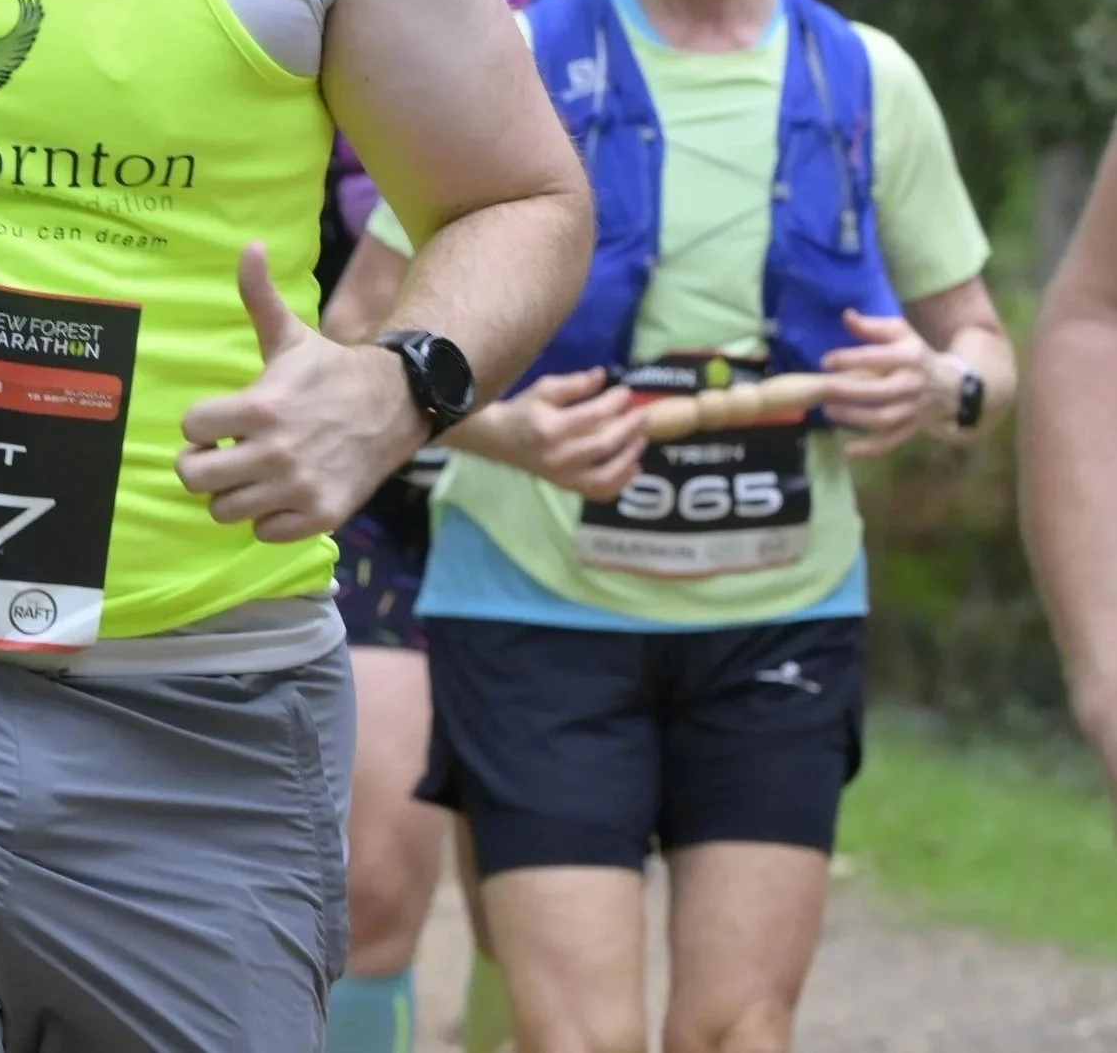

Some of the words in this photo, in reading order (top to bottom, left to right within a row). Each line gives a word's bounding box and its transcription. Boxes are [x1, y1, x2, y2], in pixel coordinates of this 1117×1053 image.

[38, 225, 82, 241] can
[95, 228, 169, 248] dream
[29, 317, 104, 342] FOREST
[617, 471, 783, 521] 965
[14, 605, 54, 622] RAFT
